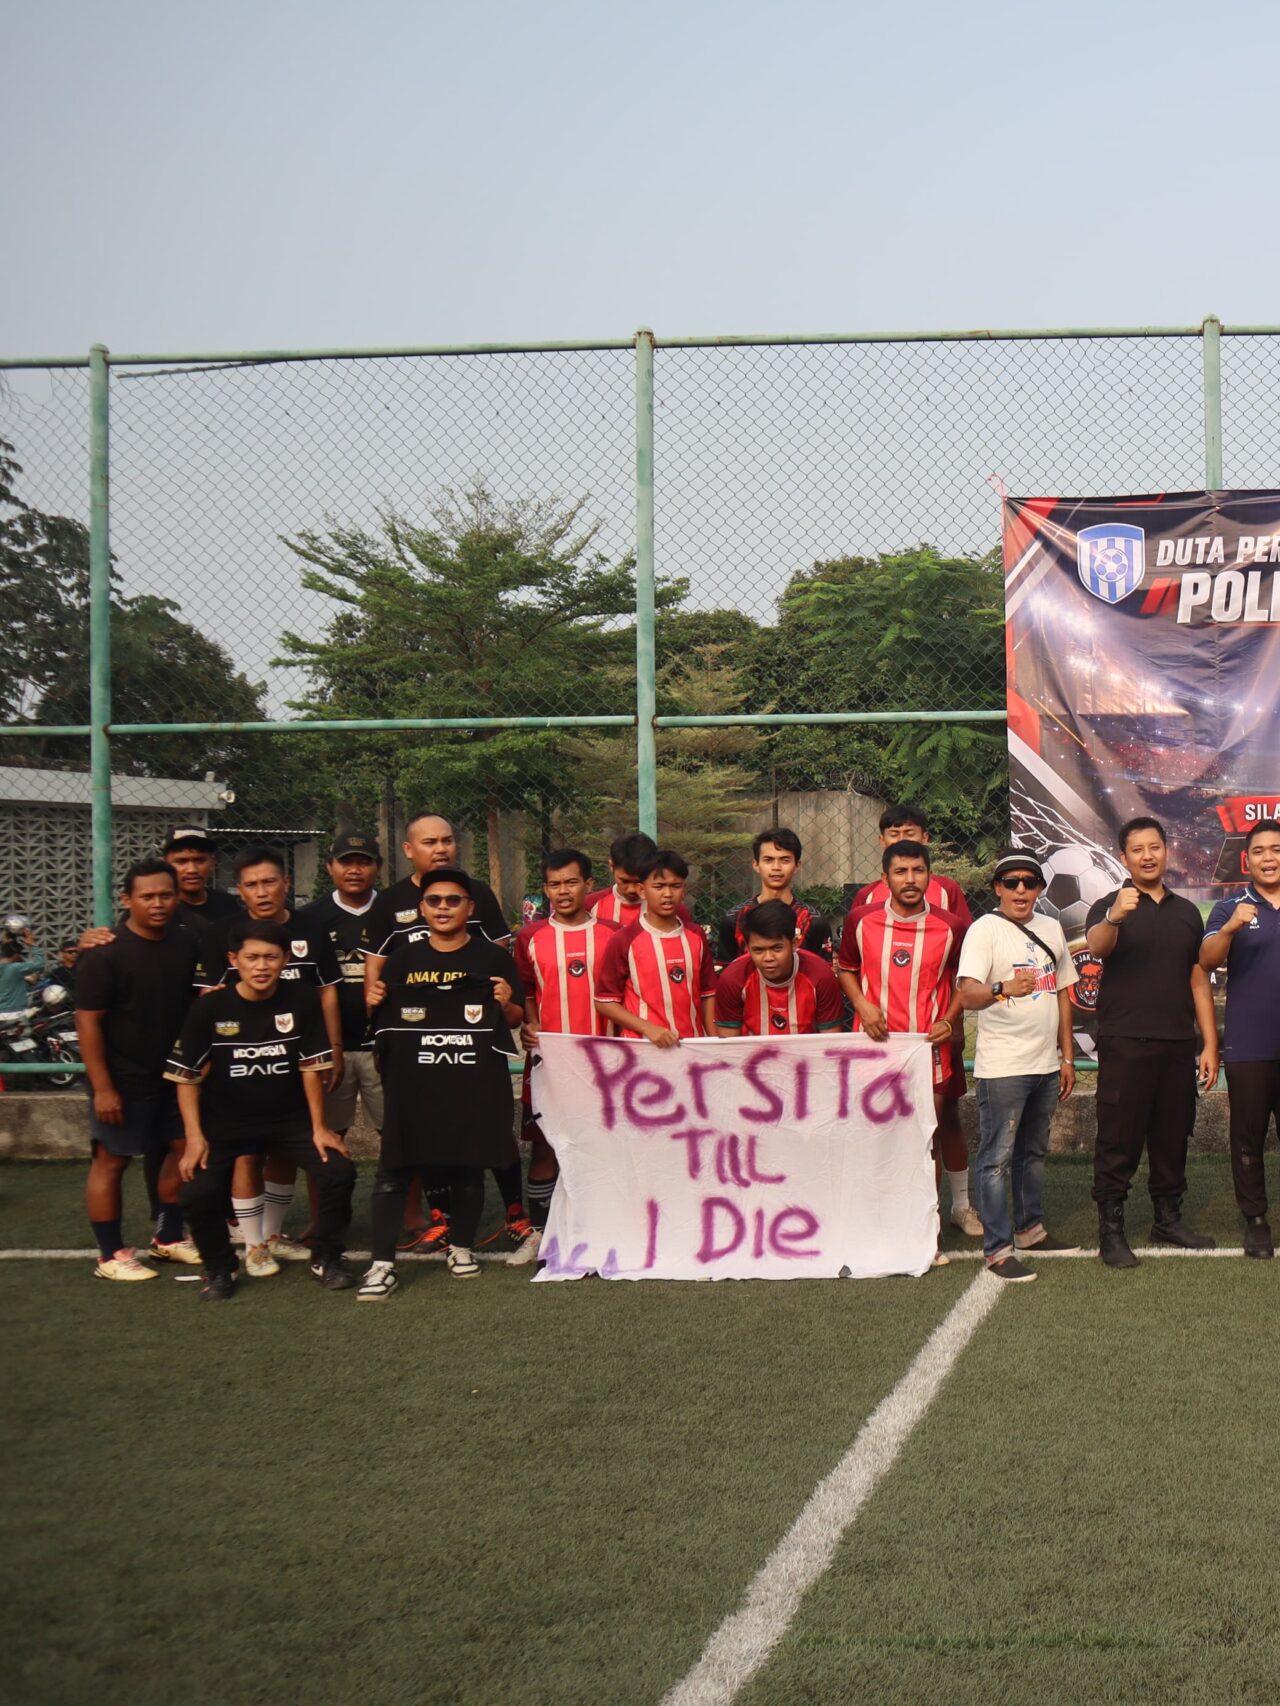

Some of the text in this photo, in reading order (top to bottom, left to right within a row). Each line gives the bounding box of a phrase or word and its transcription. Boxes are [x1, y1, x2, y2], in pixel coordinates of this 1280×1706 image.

[1156, 536, 1224, 566] DUTA
[406, 971, 467, 985] ANAK DE
[418, 1051, 477, 1064] BAIC
[229, 1061, 290, 1077] BAIC
